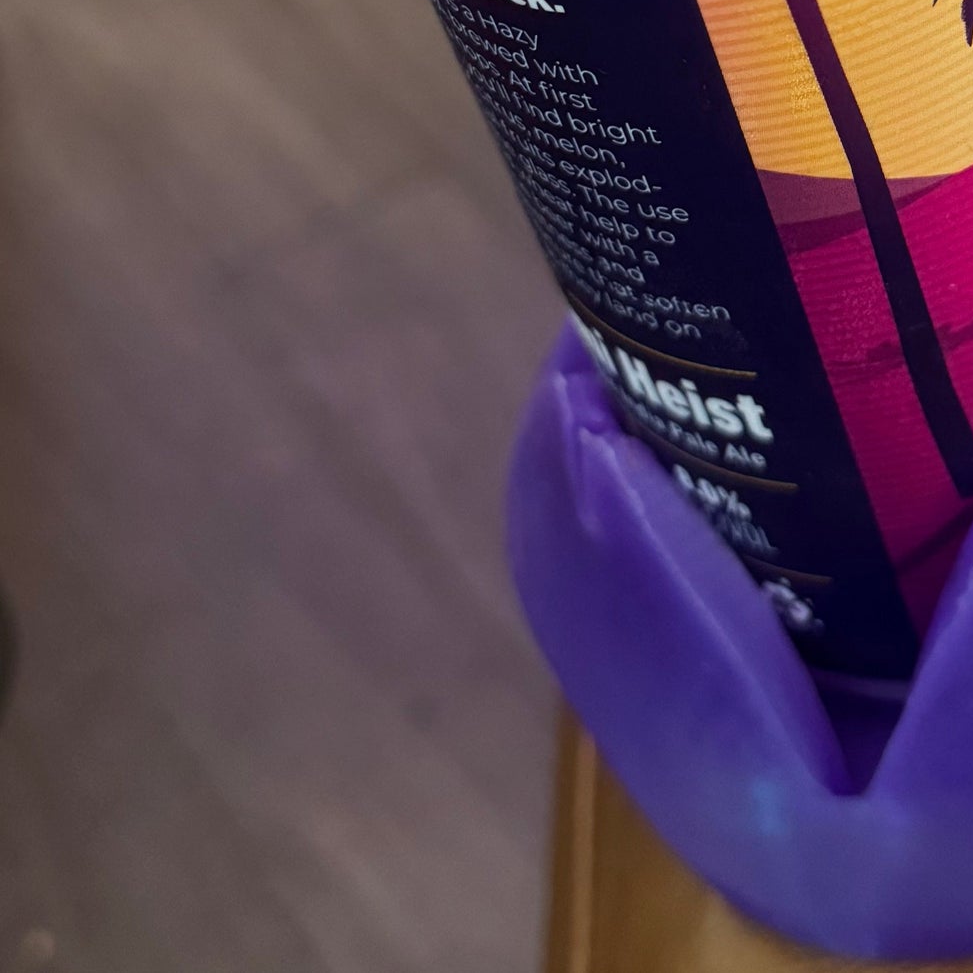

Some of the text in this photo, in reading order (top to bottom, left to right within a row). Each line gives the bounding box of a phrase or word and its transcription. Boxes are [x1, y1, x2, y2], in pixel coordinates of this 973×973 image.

[461, 5, 476, 22] a
[477, 10, 538, 51] Hazy
[509, 70, 536, 95] At
[538, 80, 597, 111] first
[533, 58, 599, 85] with
[512, 91, 563, 127] find
[567, 111, 662, 145] bright
[533, 127, 626, 169] melon,
[559, 160, 662, 193] explod-
[577, 183, 630, 214] The
[637, 202, 690, 222] use
[580, 205, 640, 240] help
[646, 226, 676, 245] to
[580, 228, 637, 260] with
[643, 250, 661, 266] a
[596, 255, 646, 284] and
[664, 320, 702, 340] on
[614, 345, 774, 444] Heist
